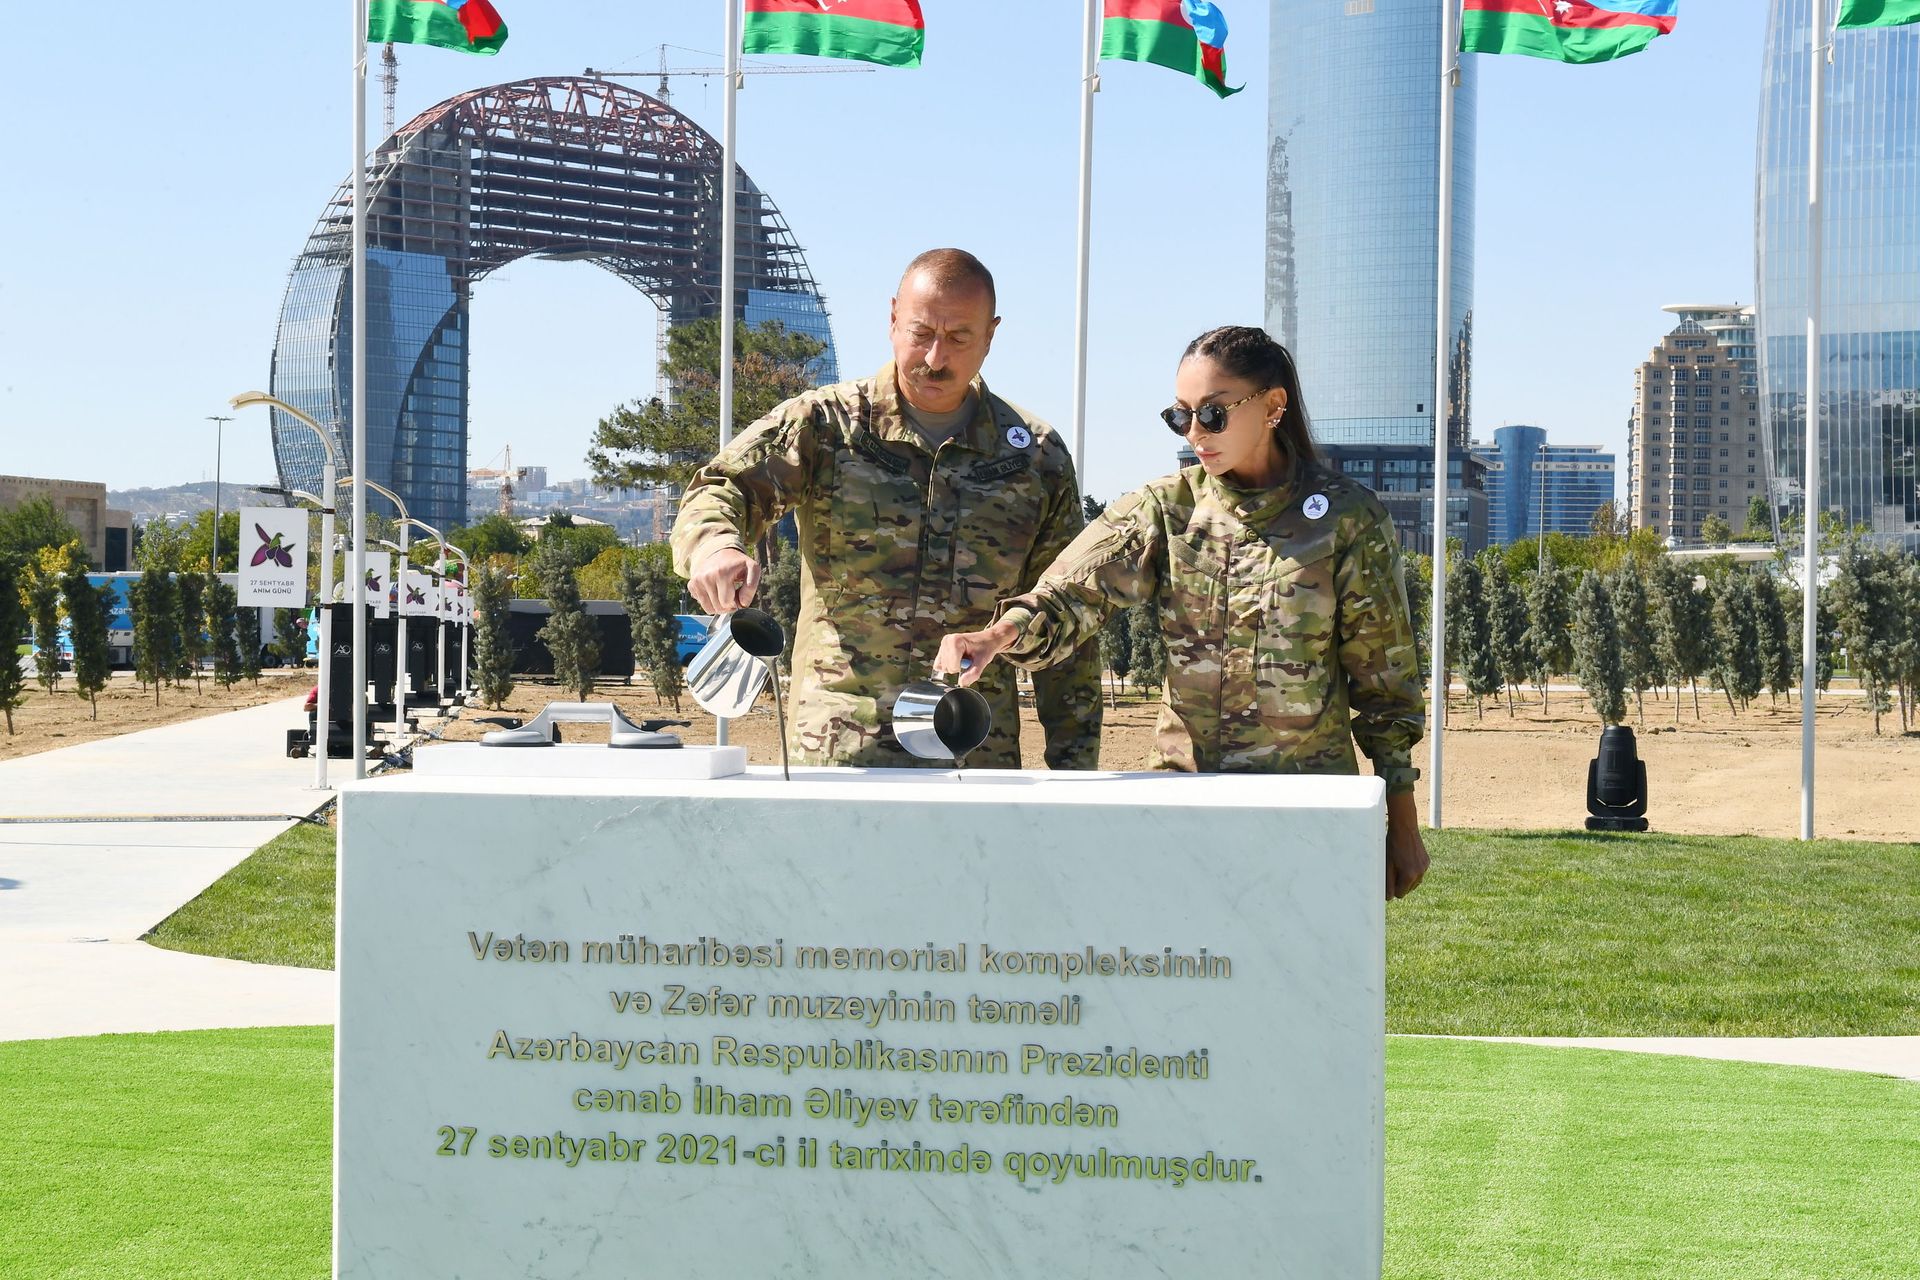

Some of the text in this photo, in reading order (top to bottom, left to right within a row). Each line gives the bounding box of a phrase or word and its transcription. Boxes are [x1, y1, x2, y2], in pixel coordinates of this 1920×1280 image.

[467, 931, 1232, 982] Vətən müharibəsi memorial kompleksinin
[609, 984, 1081, 1028] və Zəfər muzeyinin təməli
[486, 1029, 1210, 1080] Azərbaycan Respublikasının Prezidenti
[572, 1076, 1119, 1128] cənab İlham Əliyev tərəfindən
[437, 1125, 1263, 1188] 27 sentyabr 2021-ci il tarixində qoyulmuşdur.
